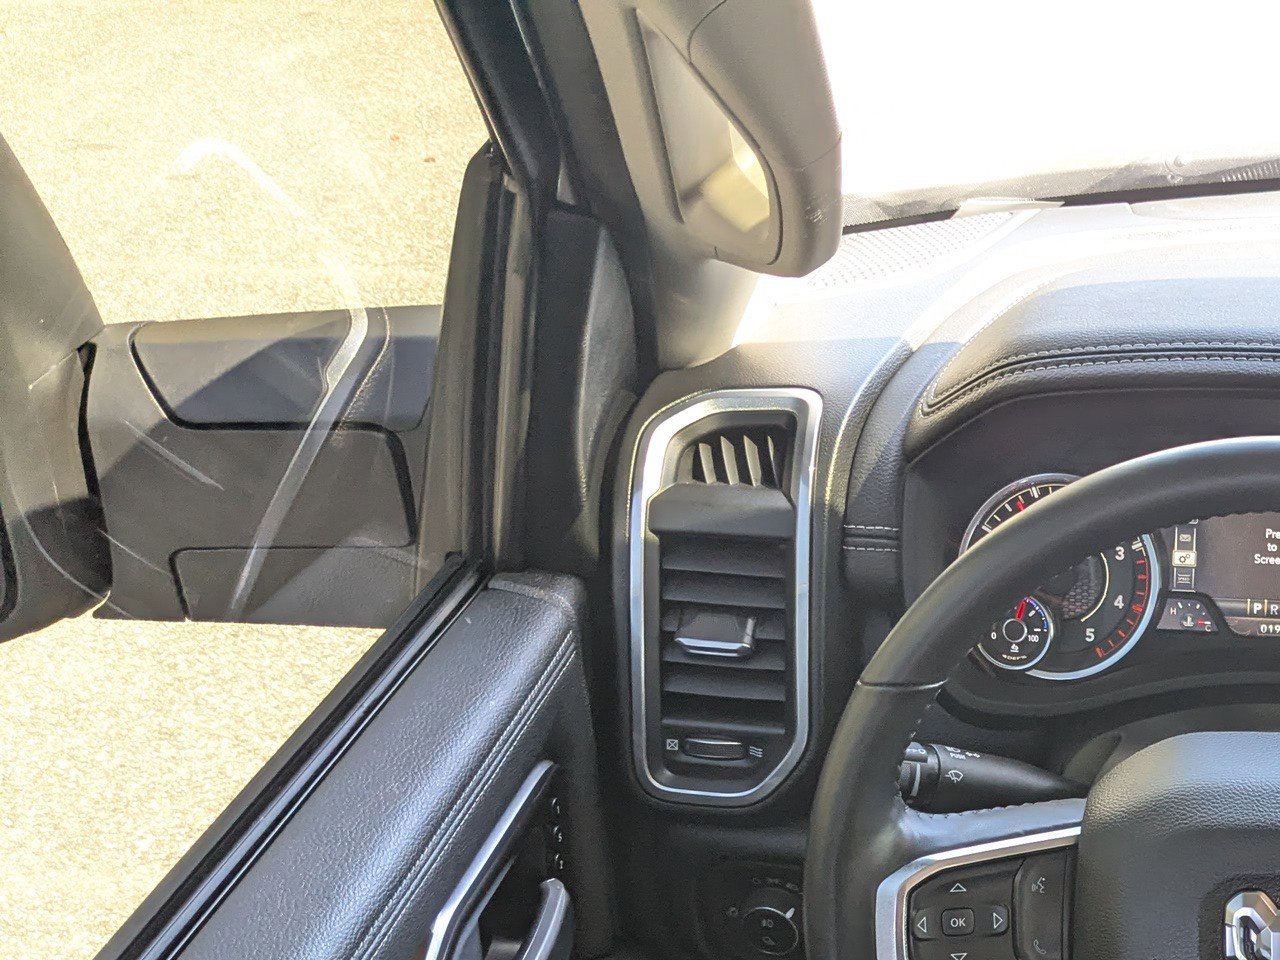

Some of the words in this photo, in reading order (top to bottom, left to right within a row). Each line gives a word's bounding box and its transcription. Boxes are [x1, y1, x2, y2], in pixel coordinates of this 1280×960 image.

[1267, 542, 1278, 552] to
[1115, 546, 1125, 560] 3
[1113, 595, 1124, 609] 4
[1170, 607, 1177, 615] H
[1253, 602, 1262, 614] P
[1270, 604, 1279, 615] R
[991, 632, 997, 640] 0
[1027, 634, 1039, 643] 100
[1085, 628, 1095, 642] 5
[950, 917, 966, 928] OK
